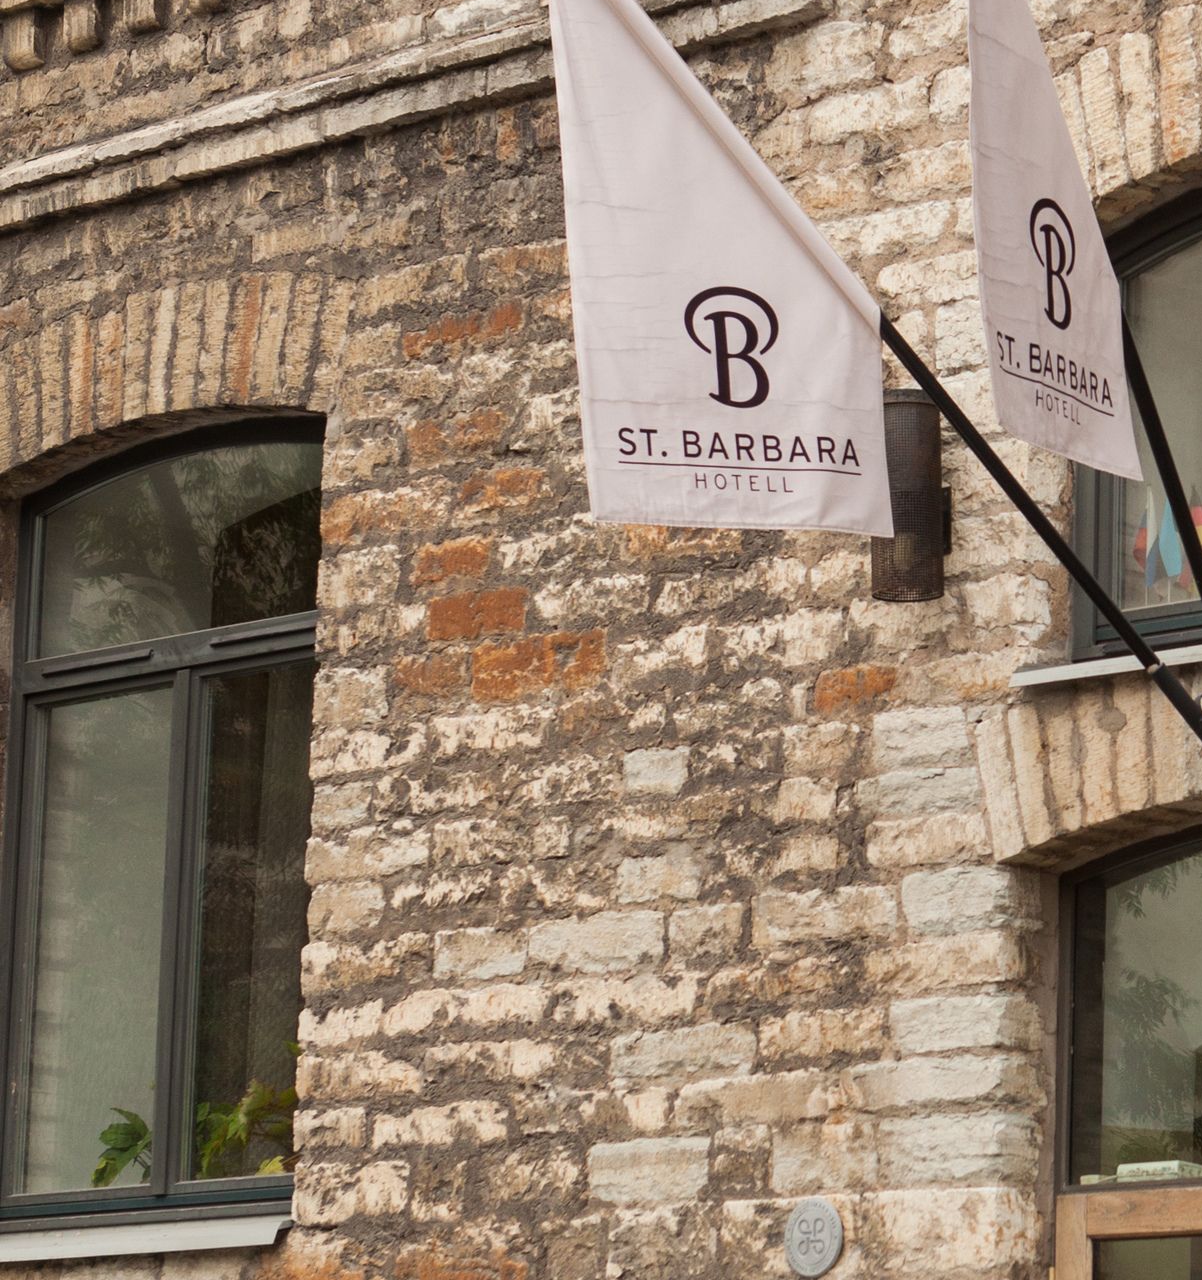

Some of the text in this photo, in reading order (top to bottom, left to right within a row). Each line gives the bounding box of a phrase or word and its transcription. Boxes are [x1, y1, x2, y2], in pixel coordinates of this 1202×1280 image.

[1029, 198, 1076, 330] B
[684, 286, 779, 409] B
[996, 331, 1113, 408] ST. BARBARA
[1036, 389, 1081, 426] HOTELL
[618, 427, 860, 467] ST. BARBARA
[694, 472, 795, 493] HOTELL
